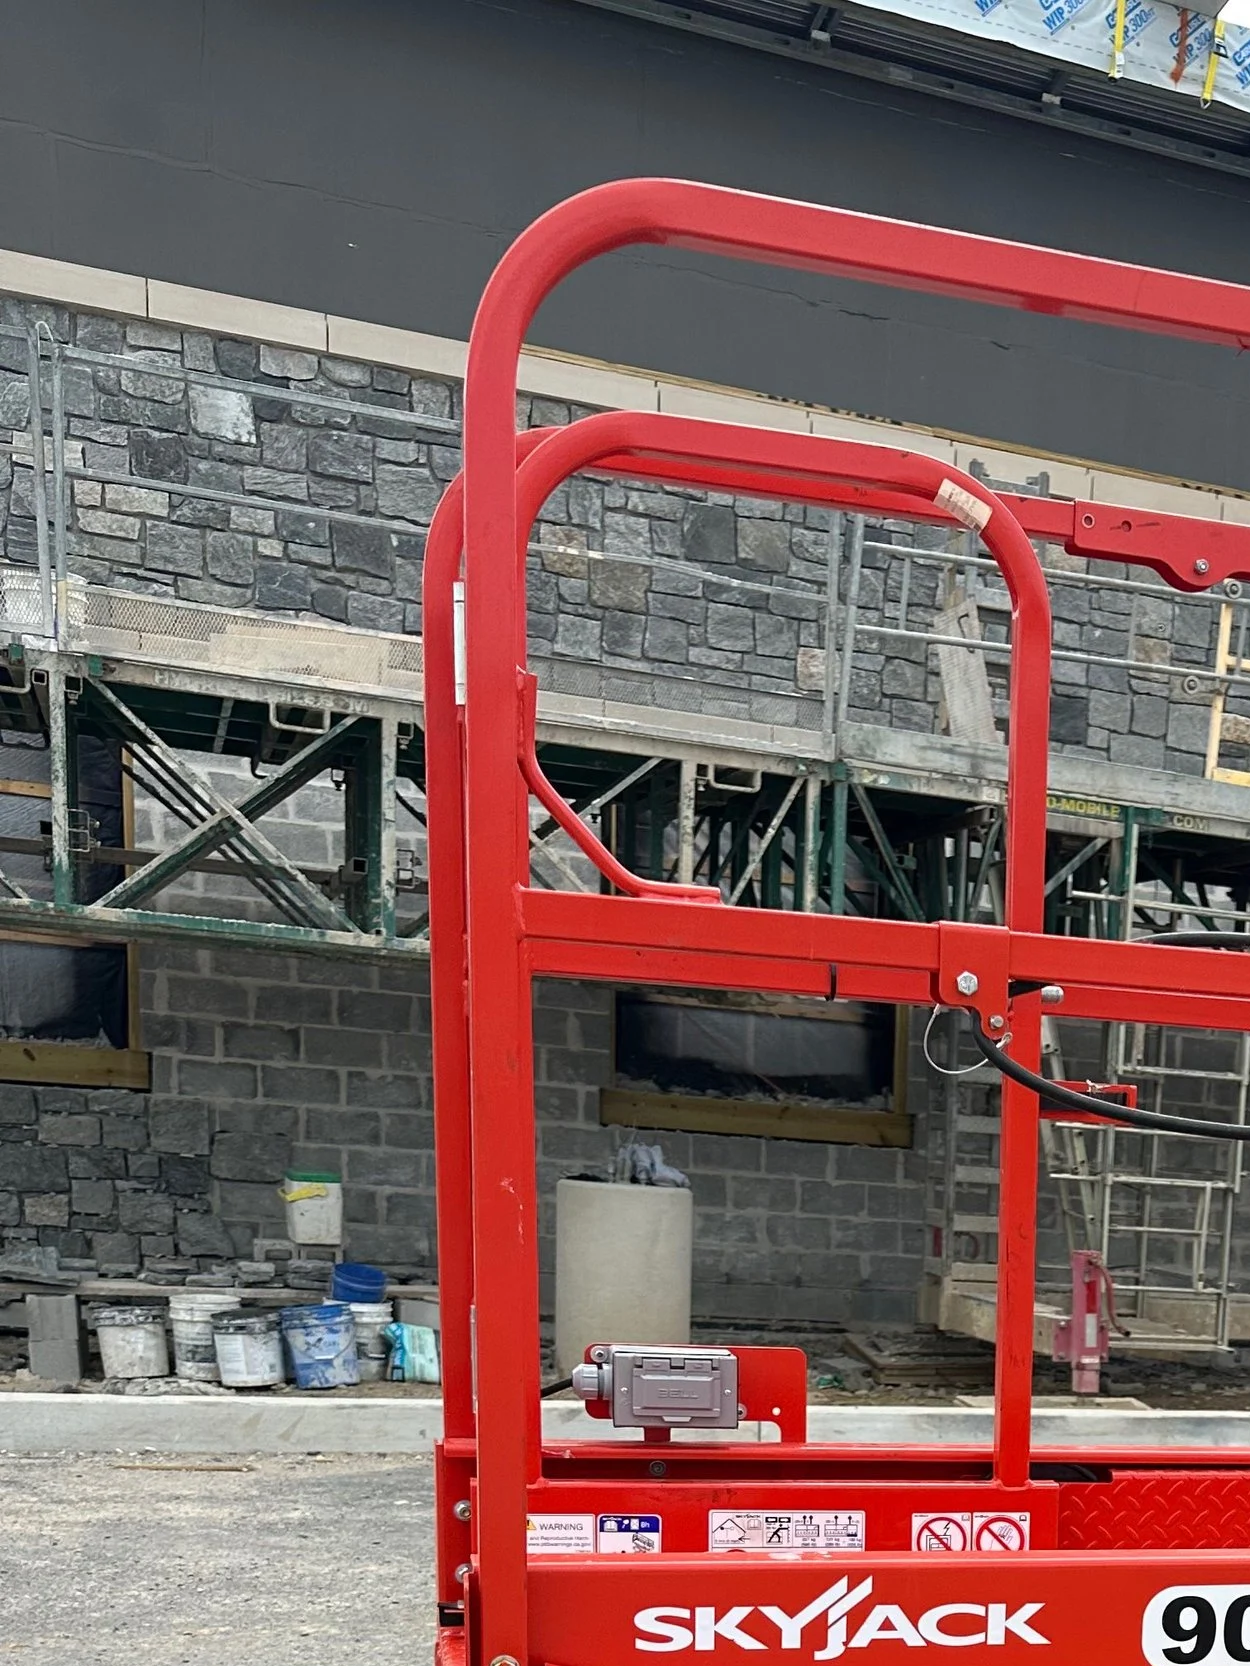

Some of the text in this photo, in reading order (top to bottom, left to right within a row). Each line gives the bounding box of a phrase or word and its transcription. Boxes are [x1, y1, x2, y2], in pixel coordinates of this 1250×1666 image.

[1042, 6, 1065, 30] WIP
[539, 1523, 583, 1531] WARNING
[633, 1575, 1051, 1661] SKYJACK
